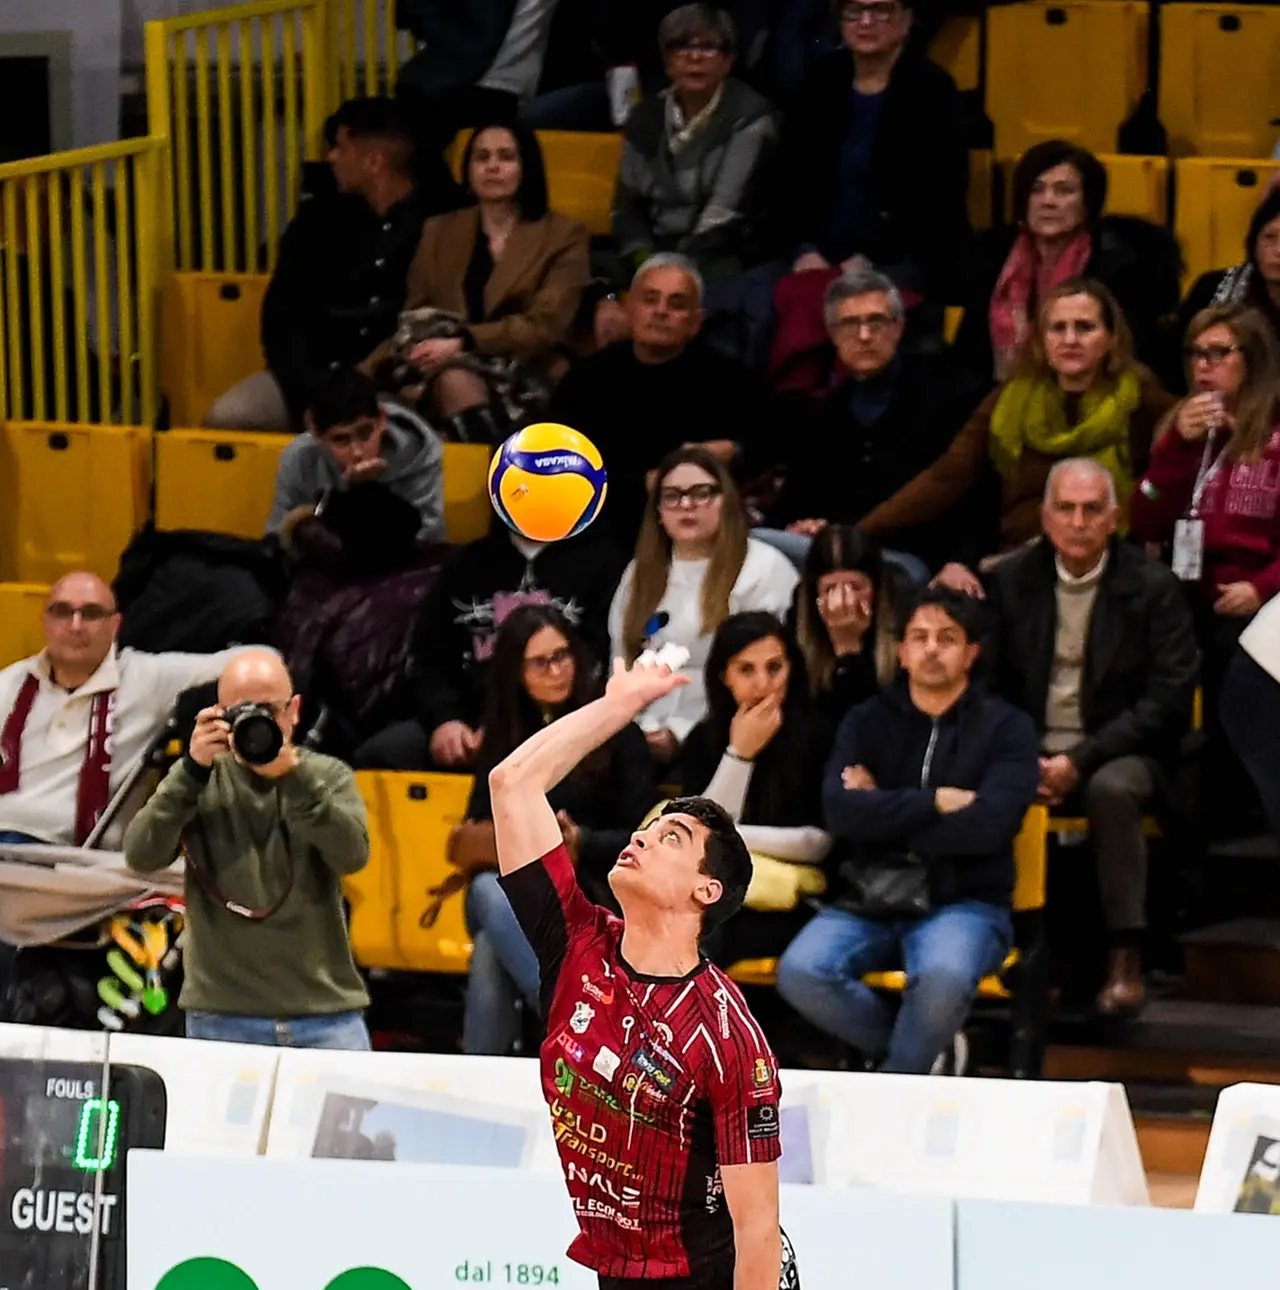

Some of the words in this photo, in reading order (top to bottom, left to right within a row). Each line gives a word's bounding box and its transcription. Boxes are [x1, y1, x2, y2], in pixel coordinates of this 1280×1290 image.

[46, 1077, 94, 1101] FOULS
[73, 1098, 119, 1170] 0
[11, 1189, 117, 1235] GUEST
[455, 1259, 493, 1283] dal
[502, 1263, 560, 1286] 1894
